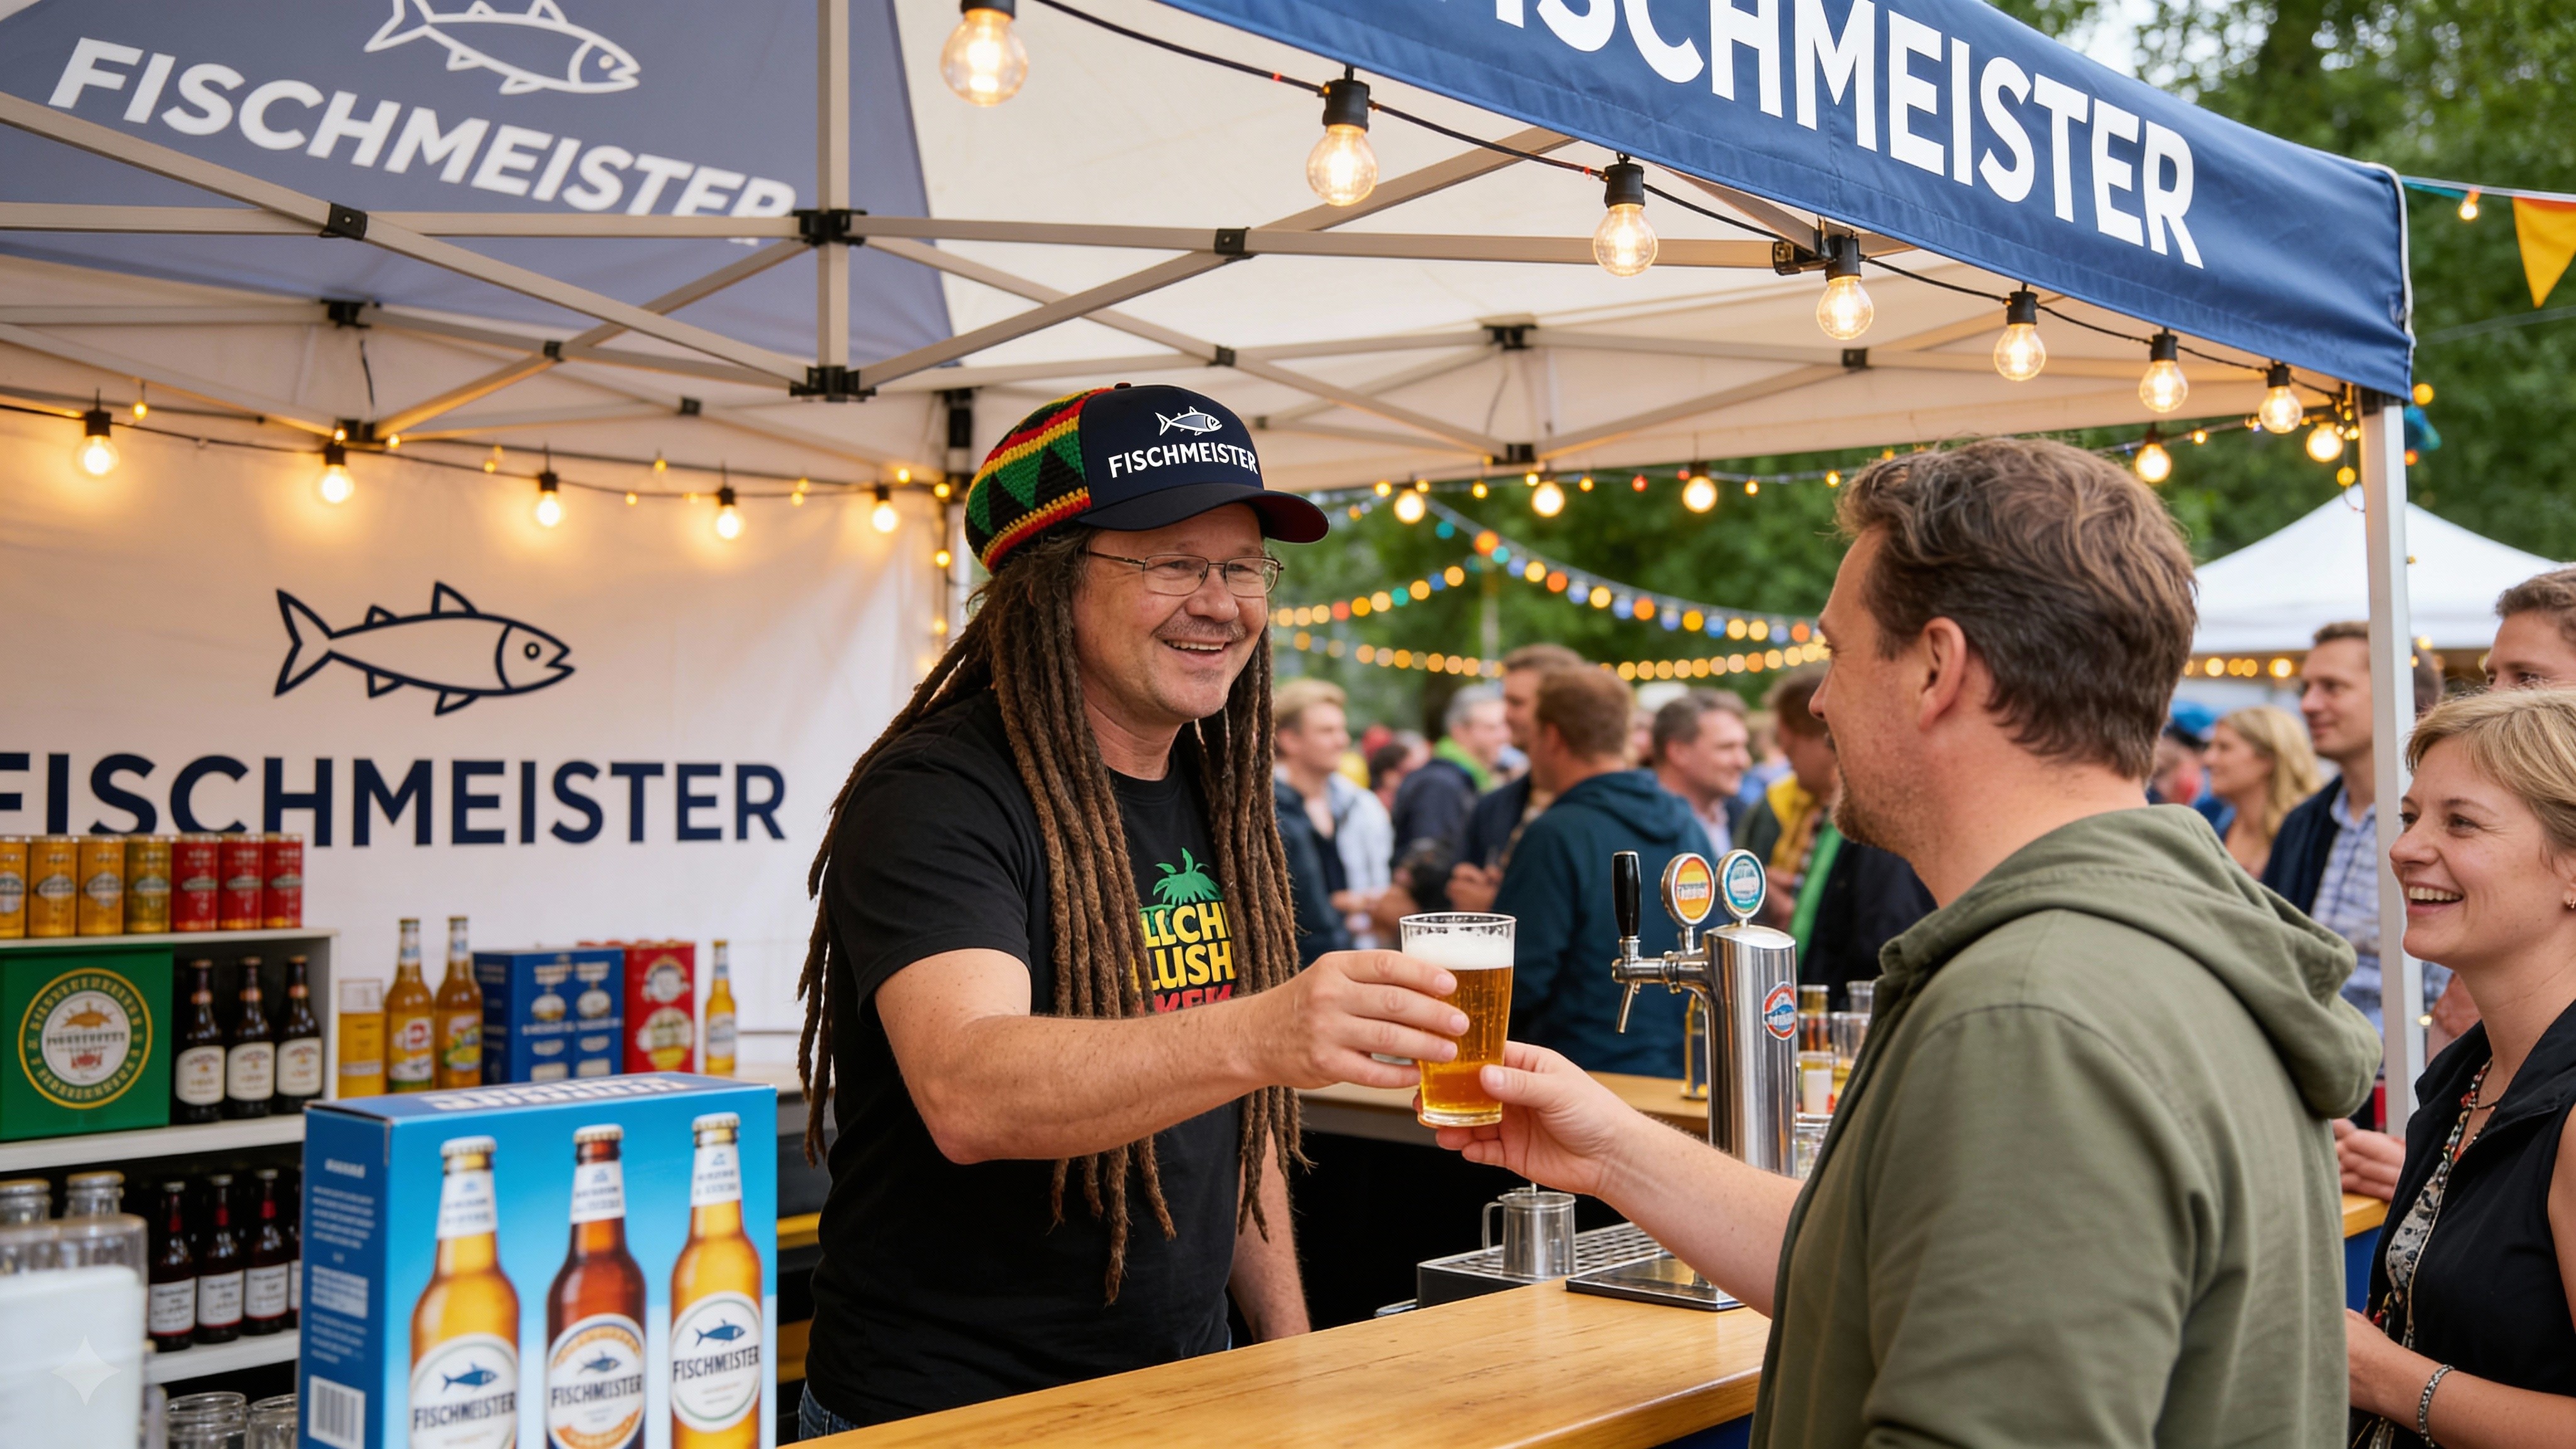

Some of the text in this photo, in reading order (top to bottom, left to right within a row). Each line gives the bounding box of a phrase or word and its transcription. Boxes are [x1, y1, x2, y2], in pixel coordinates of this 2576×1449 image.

[47, 36, 797, 246] FISCHMEISTER
[1108, 442, 1258, 478] FISCHMEISTER
[673, 1345, 758, 1382] FISCHMEISTER
